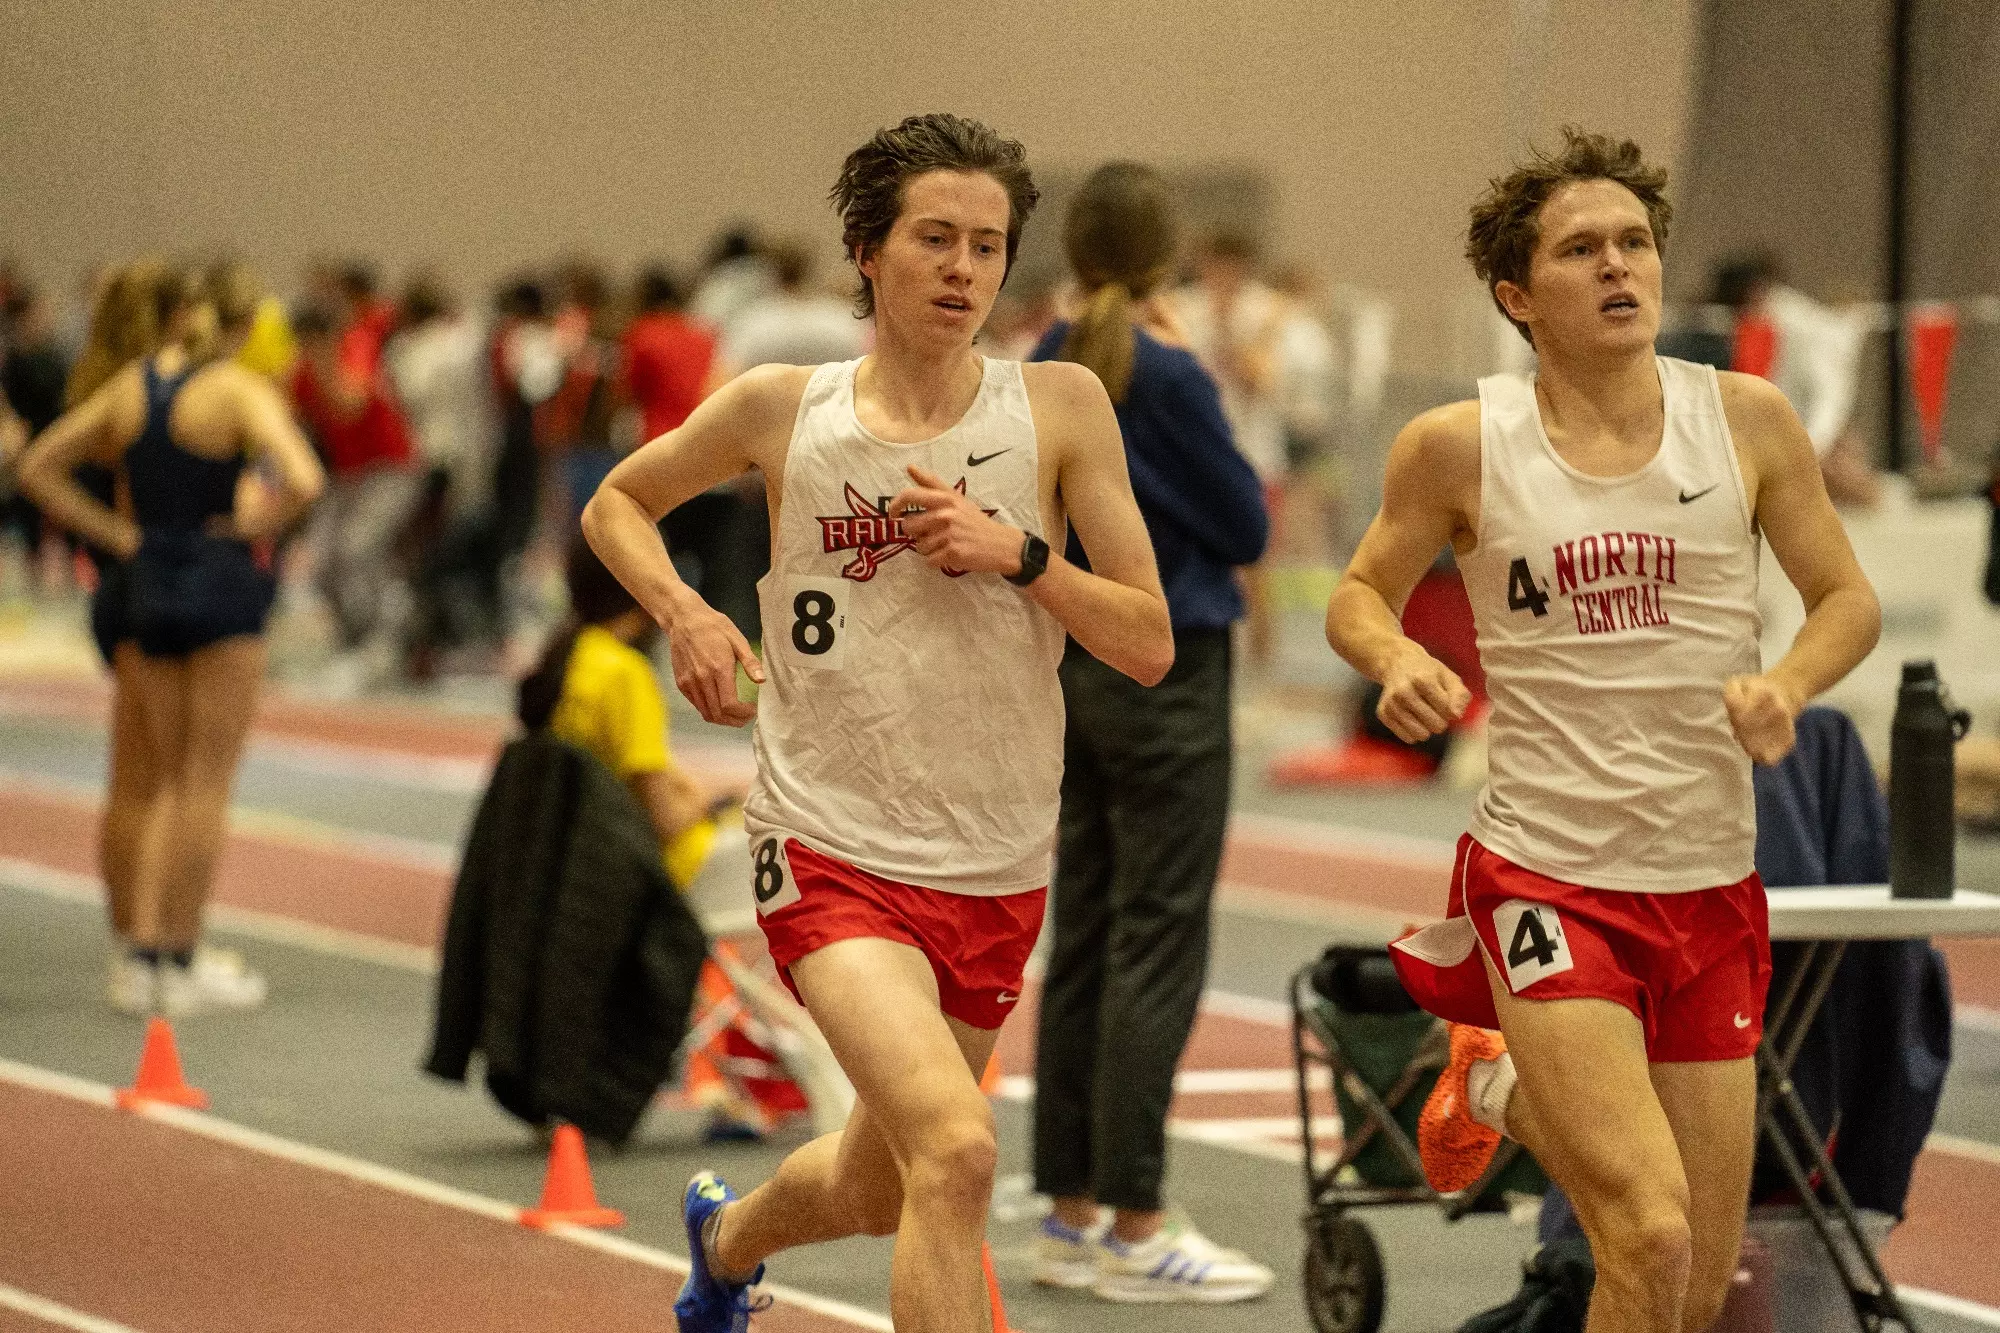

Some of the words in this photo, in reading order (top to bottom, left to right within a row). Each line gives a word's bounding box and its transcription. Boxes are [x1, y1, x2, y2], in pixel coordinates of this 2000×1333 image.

[1507, 556, 1551, 618] 4
[1553, 531, 1677, 598] NORTH
[792, 590, 836, 655] 8
[1571, 583, 1670, 635] CENTRAL
[755, 838, 783, 903] 8
[1508, 908, 1559, 970] 4
